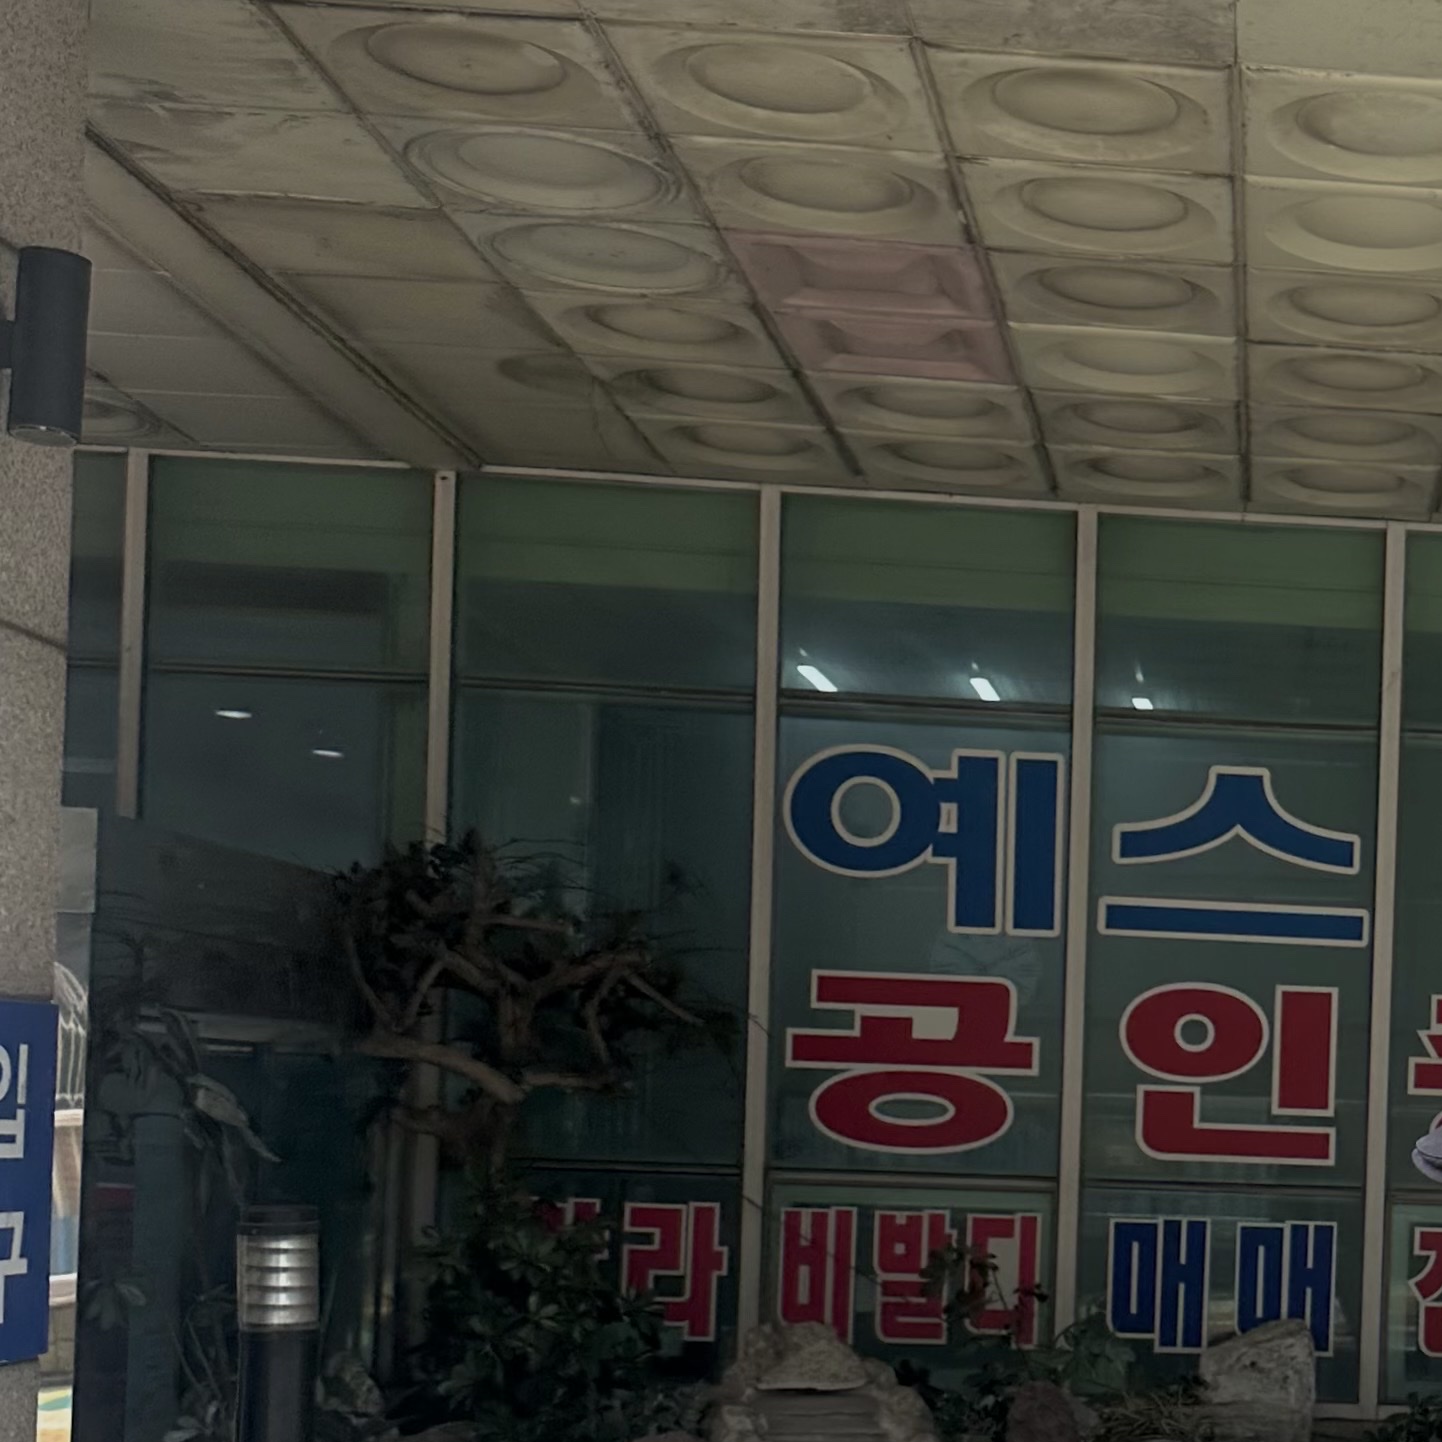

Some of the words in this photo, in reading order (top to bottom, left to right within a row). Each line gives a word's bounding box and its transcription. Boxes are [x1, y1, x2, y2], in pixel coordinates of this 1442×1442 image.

[783, 743, 1369, 947] 예스
[529, 1197, 1042, 1348] 라비발디
[1107, 1217, 1337, 1357] 매매
